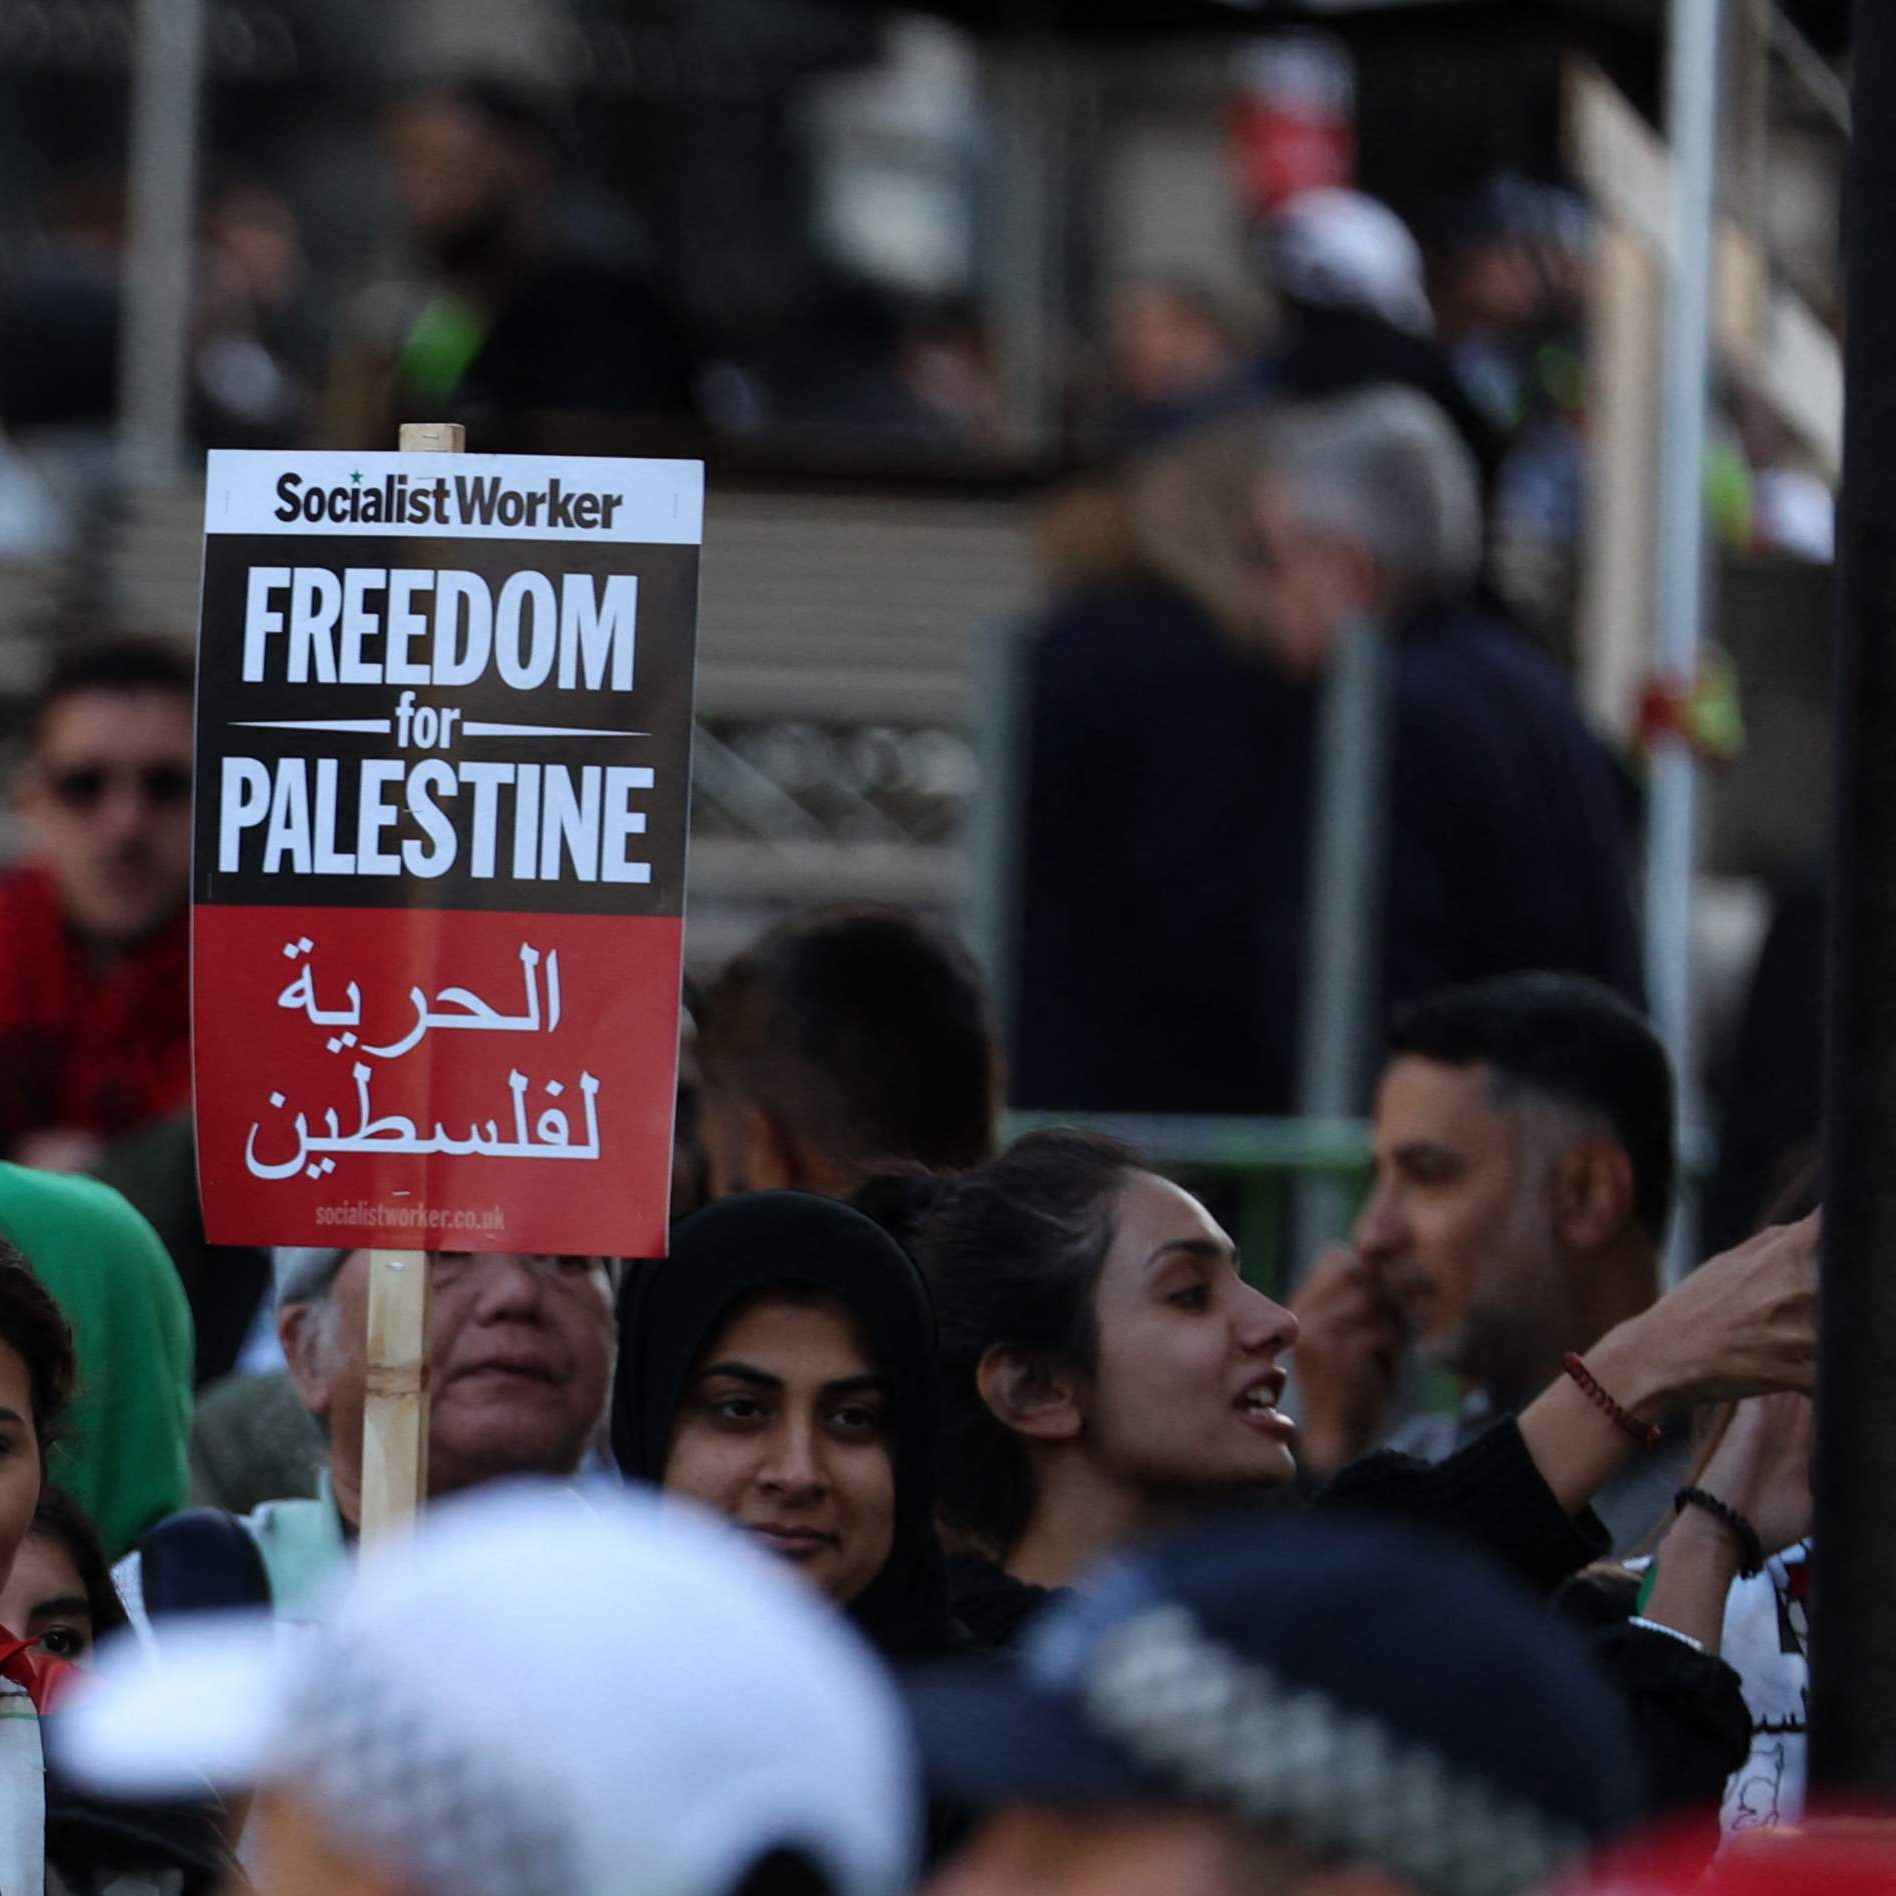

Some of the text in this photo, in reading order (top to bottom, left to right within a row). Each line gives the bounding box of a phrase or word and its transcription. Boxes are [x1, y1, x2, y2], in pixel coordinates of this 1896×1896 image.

[242, 566, 639, 692] FREEDOM
[393, 690, 462, 750] for
[217, 756, 655, 884] PALESTINE
[276, 935, 562, 1061] الحرية
[244, 1060, 602, 1182] لفلسطين
[315, 1200, 505, 1231] socialistworker.co.uk
